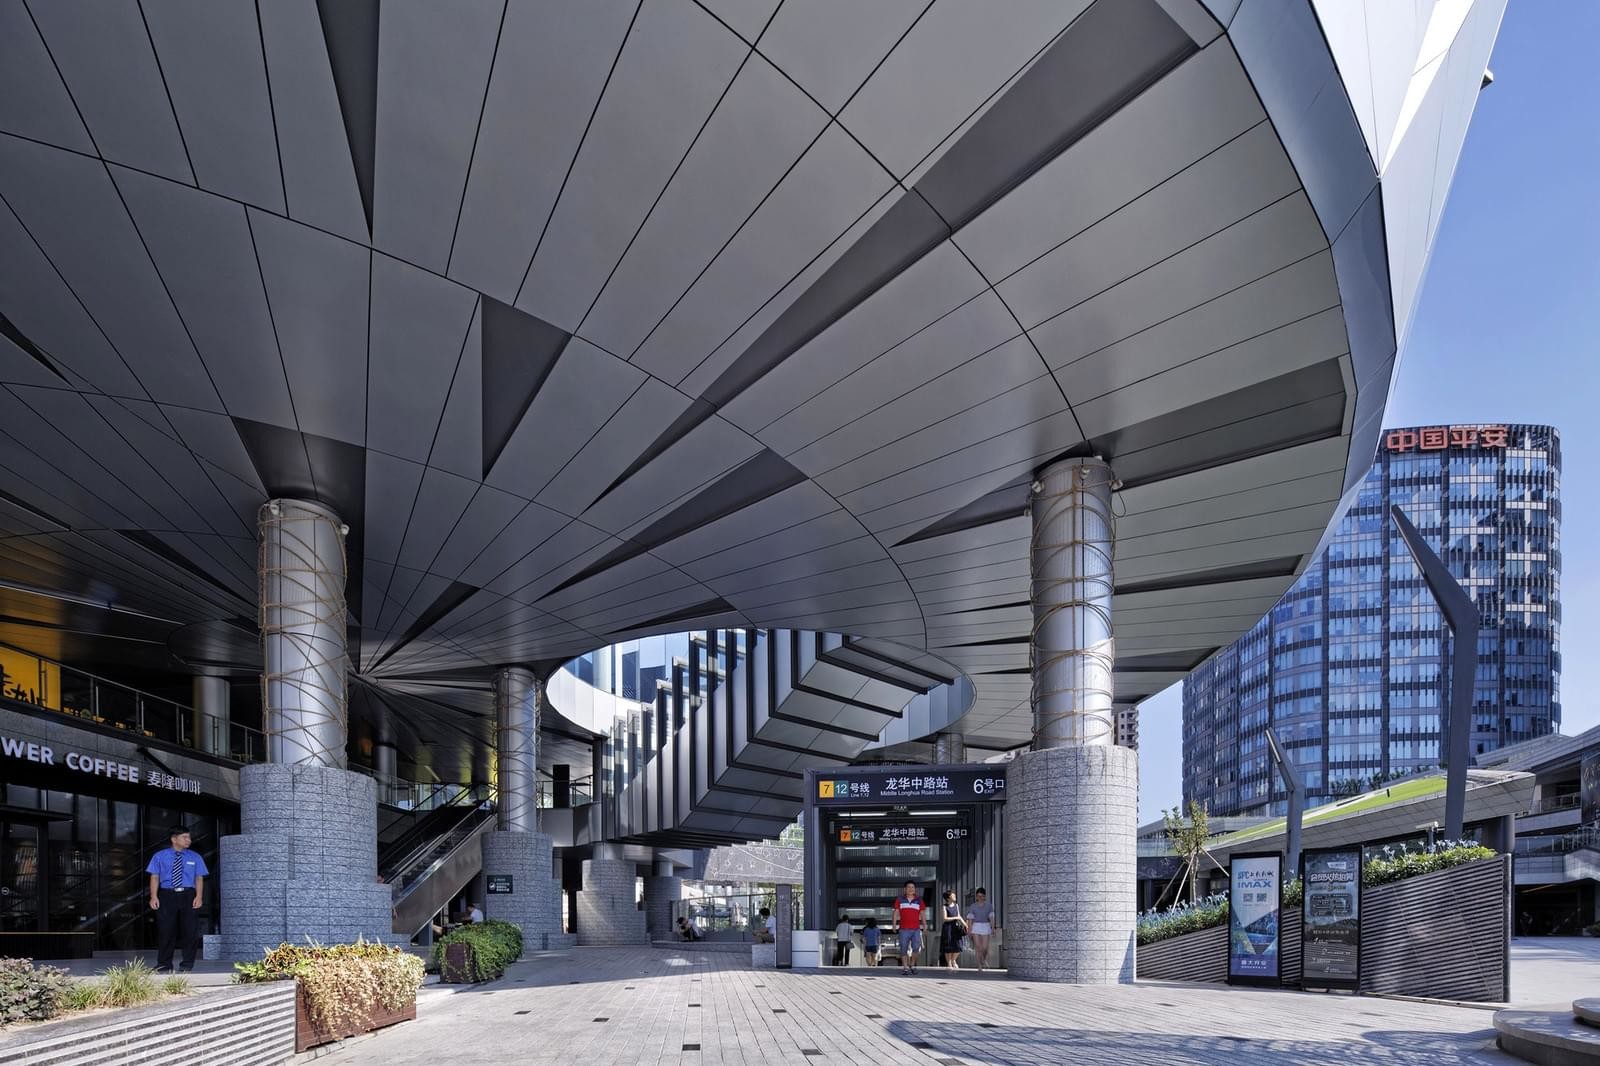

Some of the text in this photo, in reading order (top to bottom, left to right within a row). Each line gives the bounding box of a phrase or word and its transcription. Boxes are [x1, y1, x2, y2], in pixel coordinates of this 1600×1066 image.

[1386, 426, 1508, 453] 中国平安
[1, 736, 139, 784] WER COFFEE
[147, 770, 200, 795] 麦隆咖啡
[823, 782, 870, 794] 7 12 号线
[885, 776, 949, 790] 龙华中路站
[973, 778, 1004, 794] 6号口
[851, 831, 860, 840] 12
[883, 827, 925, 838] 龙华中路站
[946, 828, 967, 840] 6号口
[1238, 881, 1272, 889] IMAX
